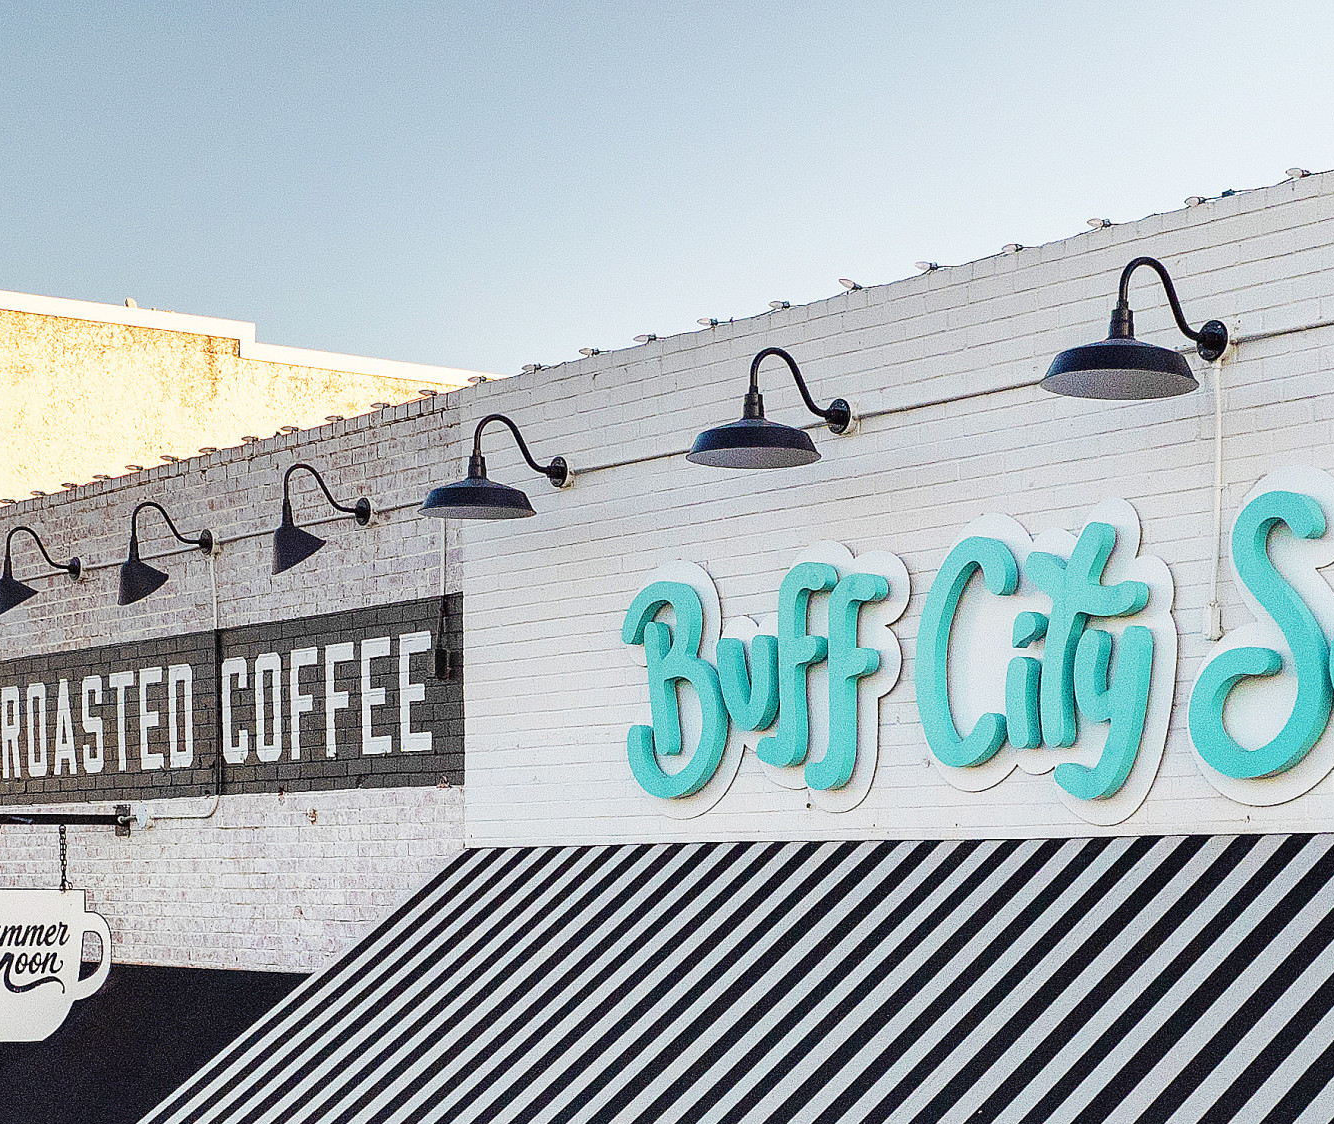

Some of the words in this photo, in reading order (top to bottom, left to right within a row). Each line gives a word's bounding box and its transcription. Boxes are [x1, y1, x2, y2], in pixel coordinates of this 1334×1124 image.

[1, 663, 193, 779] ROASTED
[222, 630, 433, 764] COFFEE
[623, 561, 890, 800] Buff
[916, 521, 1153, 801] City
